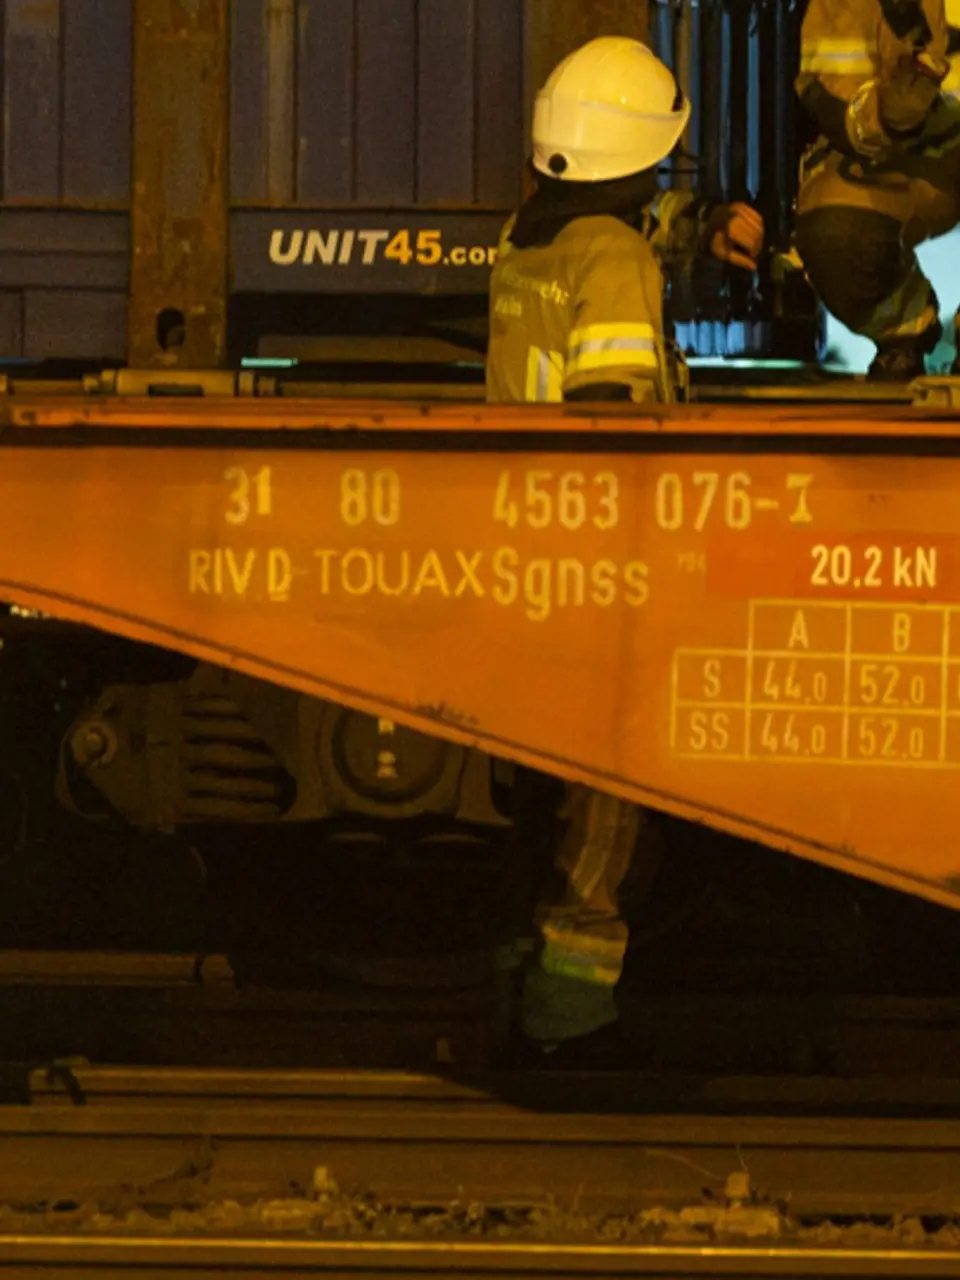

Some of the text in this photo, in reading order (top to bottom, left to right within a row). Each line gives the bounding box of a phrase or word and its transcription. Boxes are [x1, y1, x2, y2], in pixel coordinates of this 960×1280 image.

[224, 465, 272, 524] 31
[340, 468, 400, 526] 80
[493, 470, 620, 531] 4563
[189, 547, 257, 595] RIV
[491, 546, 651, 622] Sgnss
[810, 544, 938, 589] 20.2 kN
[787, 608, 809, 650] A
[892, 612, 912, 653] B
[703, 659, 722, 698] S
[689, 712, 730, 751] SS
